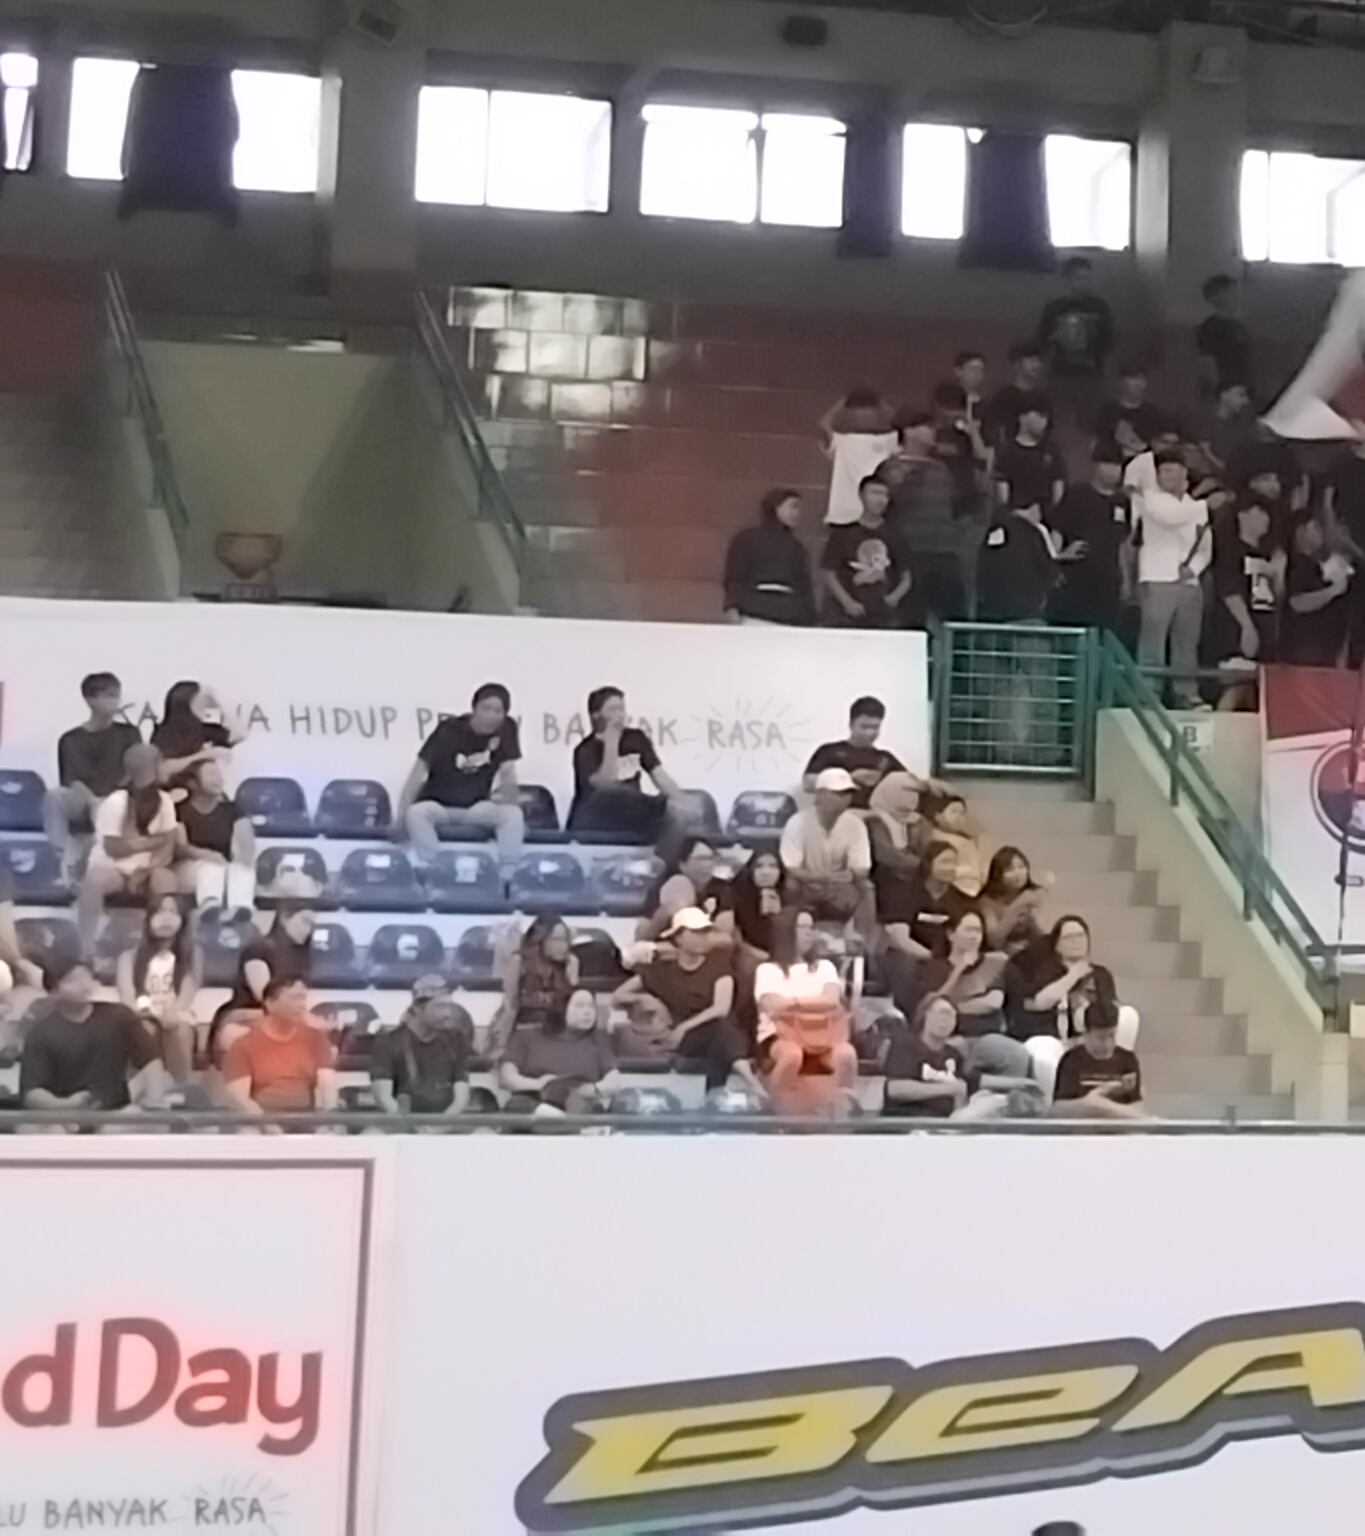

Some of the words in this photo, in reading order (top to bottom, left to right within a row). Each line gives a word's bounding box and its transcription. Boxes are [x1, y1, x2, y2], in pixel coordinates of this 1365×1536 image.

[289, 704, 399, 740] HIDUP
[706, 718, 787, 751] RASA
[44, 1497, 169, 1530] BANYAK
[194, 1495, 267, 1527] RASA
